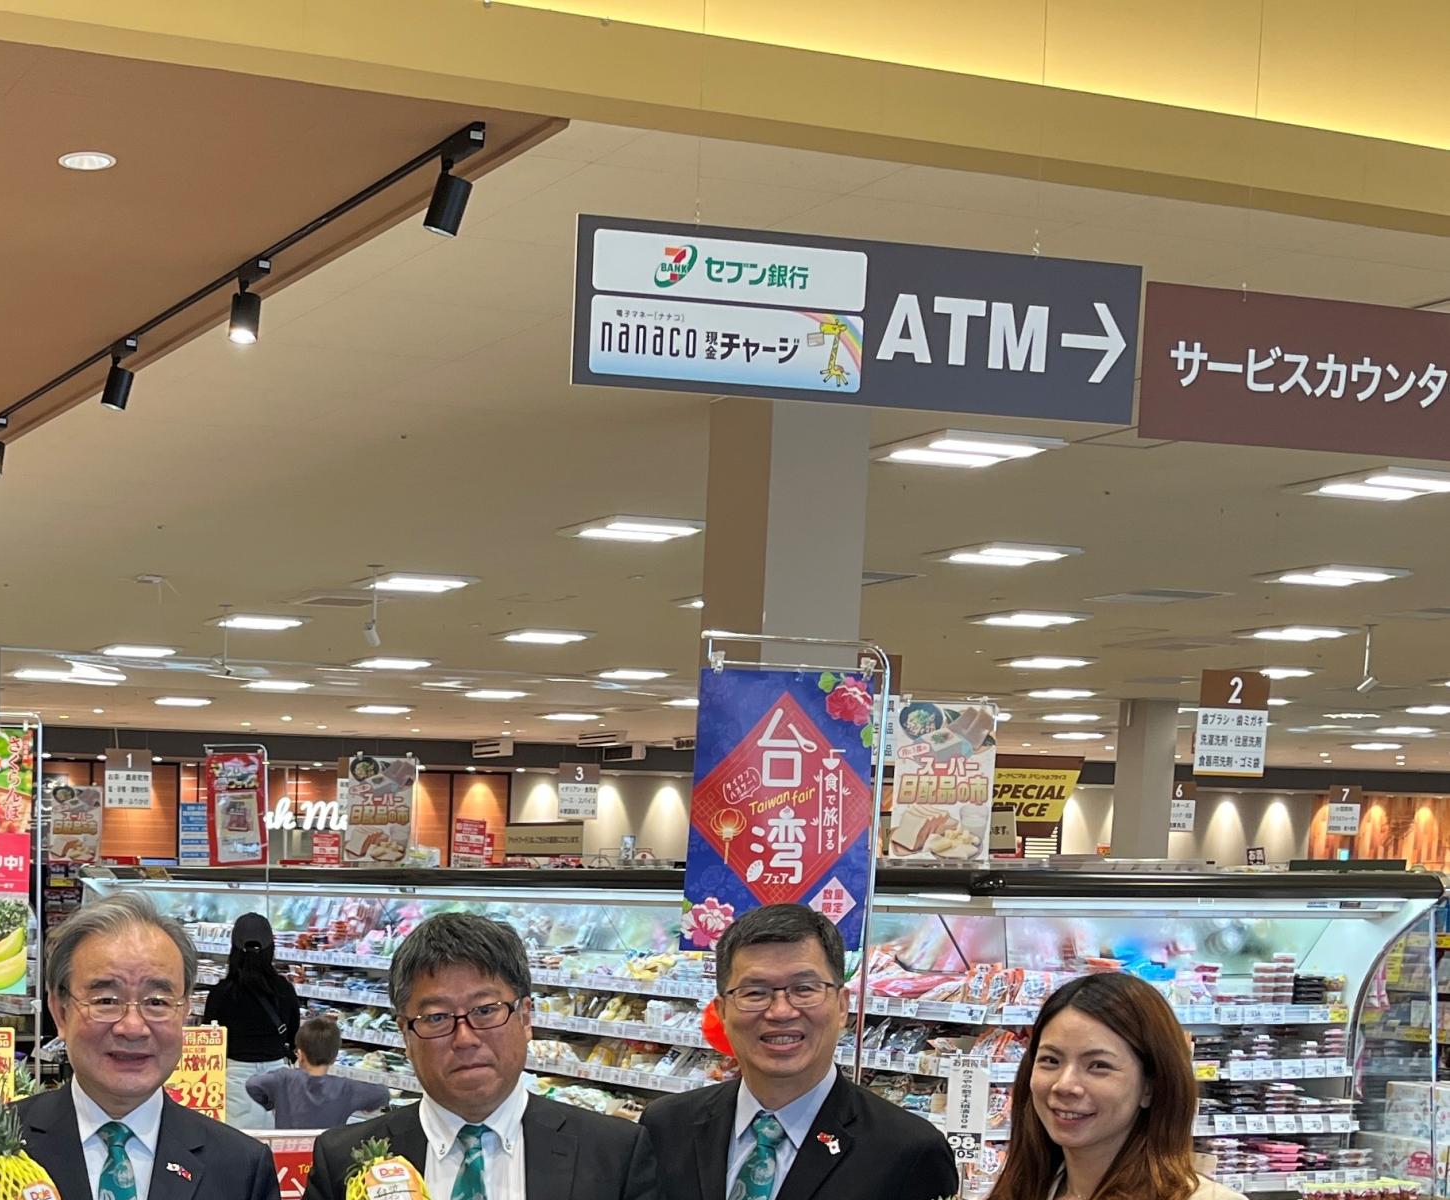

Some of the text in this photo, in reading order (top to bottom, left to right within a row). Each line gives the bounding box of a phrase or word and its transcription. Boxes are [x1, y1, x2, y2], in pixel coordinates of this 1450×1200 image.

[705, 256, 809, 290] セブン銀行
[600, 321, 697, 359] nanaco
[875, 292, 1051, 374] ATM
[1227, 676, 1243, 704] 2
[1201, 713, 1264, 727] 歯ブラシ・歯ミガキ
[126, 753, 133, 769] 1
[918, 756, 980, 777] スーパー
[575, 766, 584, 781] 3
[897, 774, 989, 806] 日配品の市
[993, 784, 1066, 800] SPECIAL
[1175, 784, 1183, 798] 6
[1342, 788, 1350, 802] 7
[363, 793, 405, 805] スーパー
[749, 787, 816, 816] Taiwan fair
[822, 772, 839, 851] 食で旅する
[763, 873, 789, 885] フェア
[182, 1031, 221, 1045] 得商品
[956, 1150, 974, 1159] 05
[380, 1166, 405, 1177] Dole
